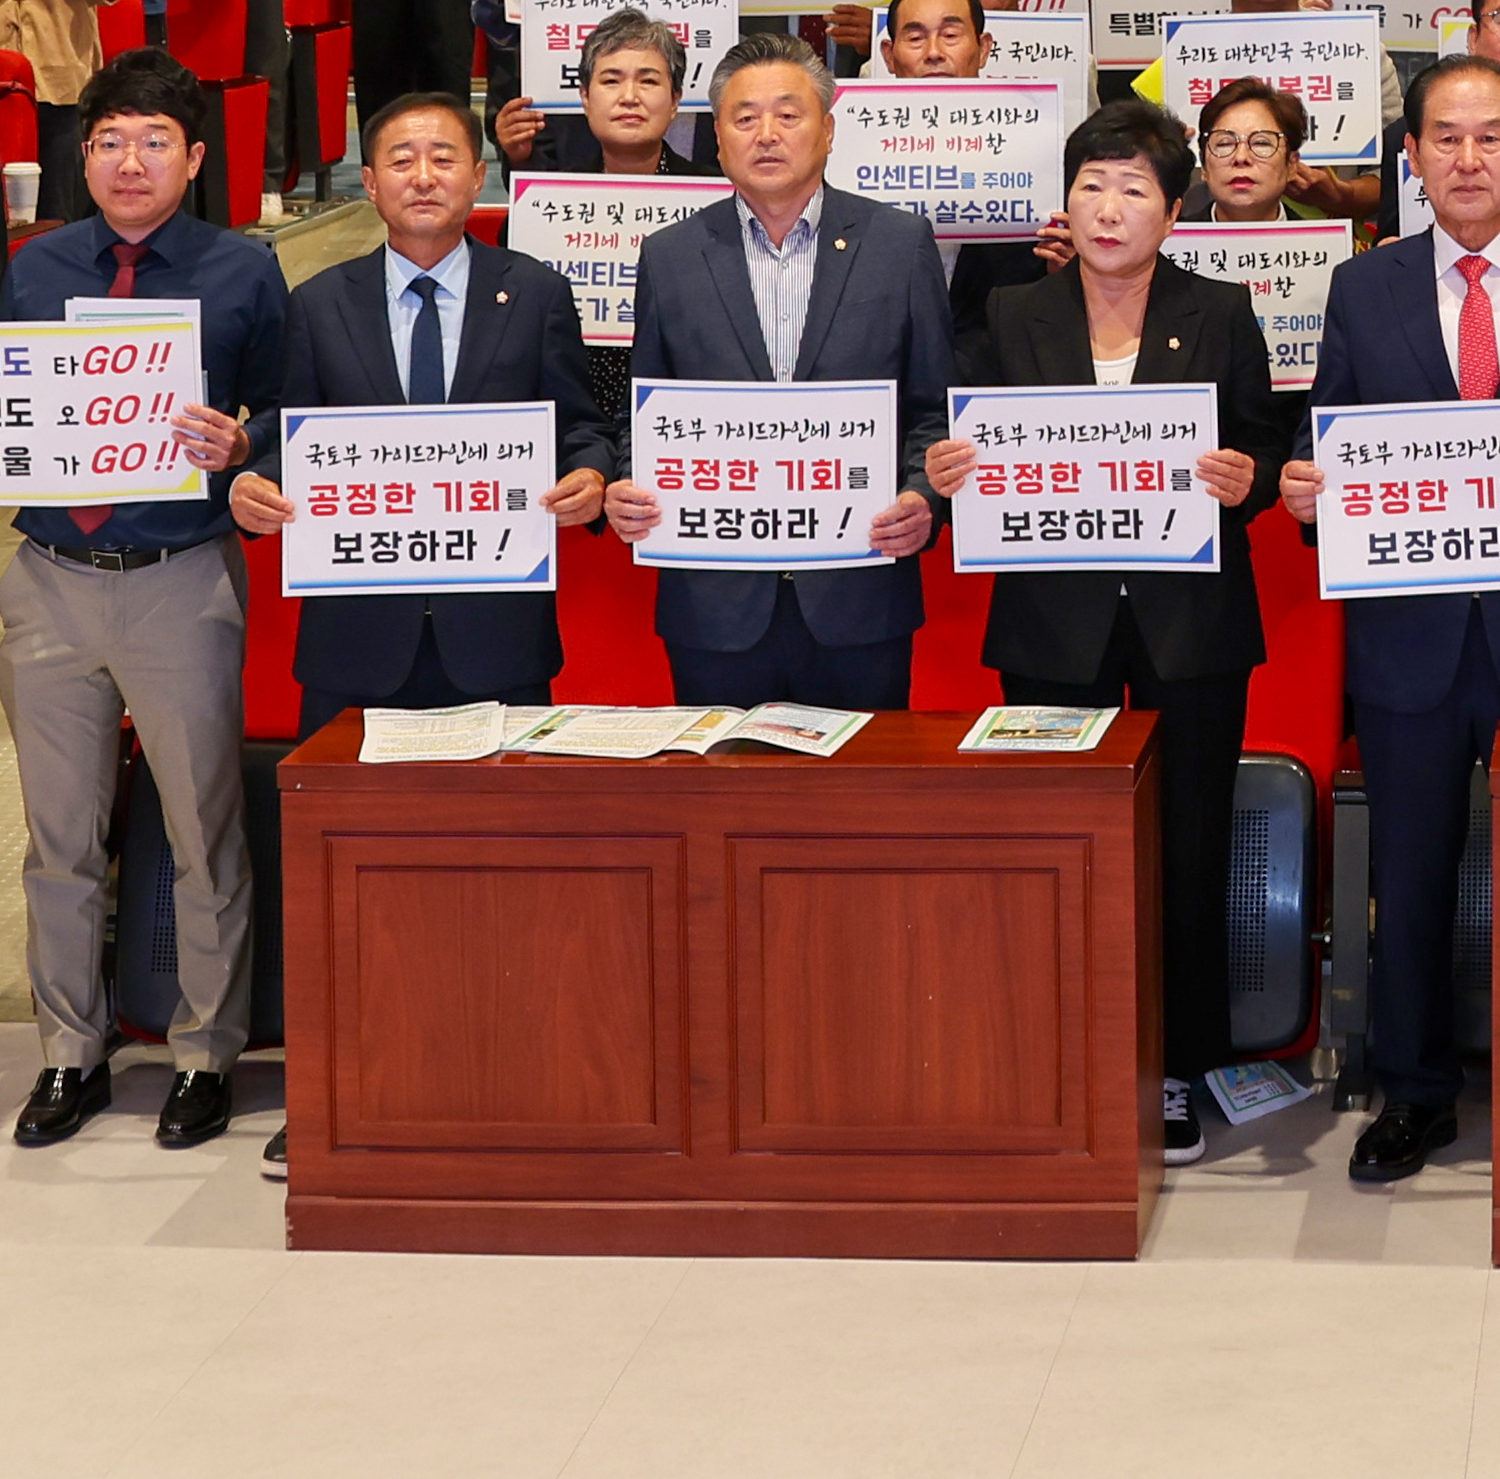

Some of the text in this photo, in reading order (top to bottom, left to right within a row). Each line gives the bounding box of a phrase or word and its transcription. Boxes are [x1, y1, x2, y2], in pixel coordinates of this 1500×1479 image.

[972, 420, 1196, 448] 국토부 가이드라인에 의거
[305, 440, 533, 469] 국토부 가이드라인에 의거
[975, 459, 1192, 495] 공정한 기회를
[307, 480, 528, 516] 공정한 기회를
